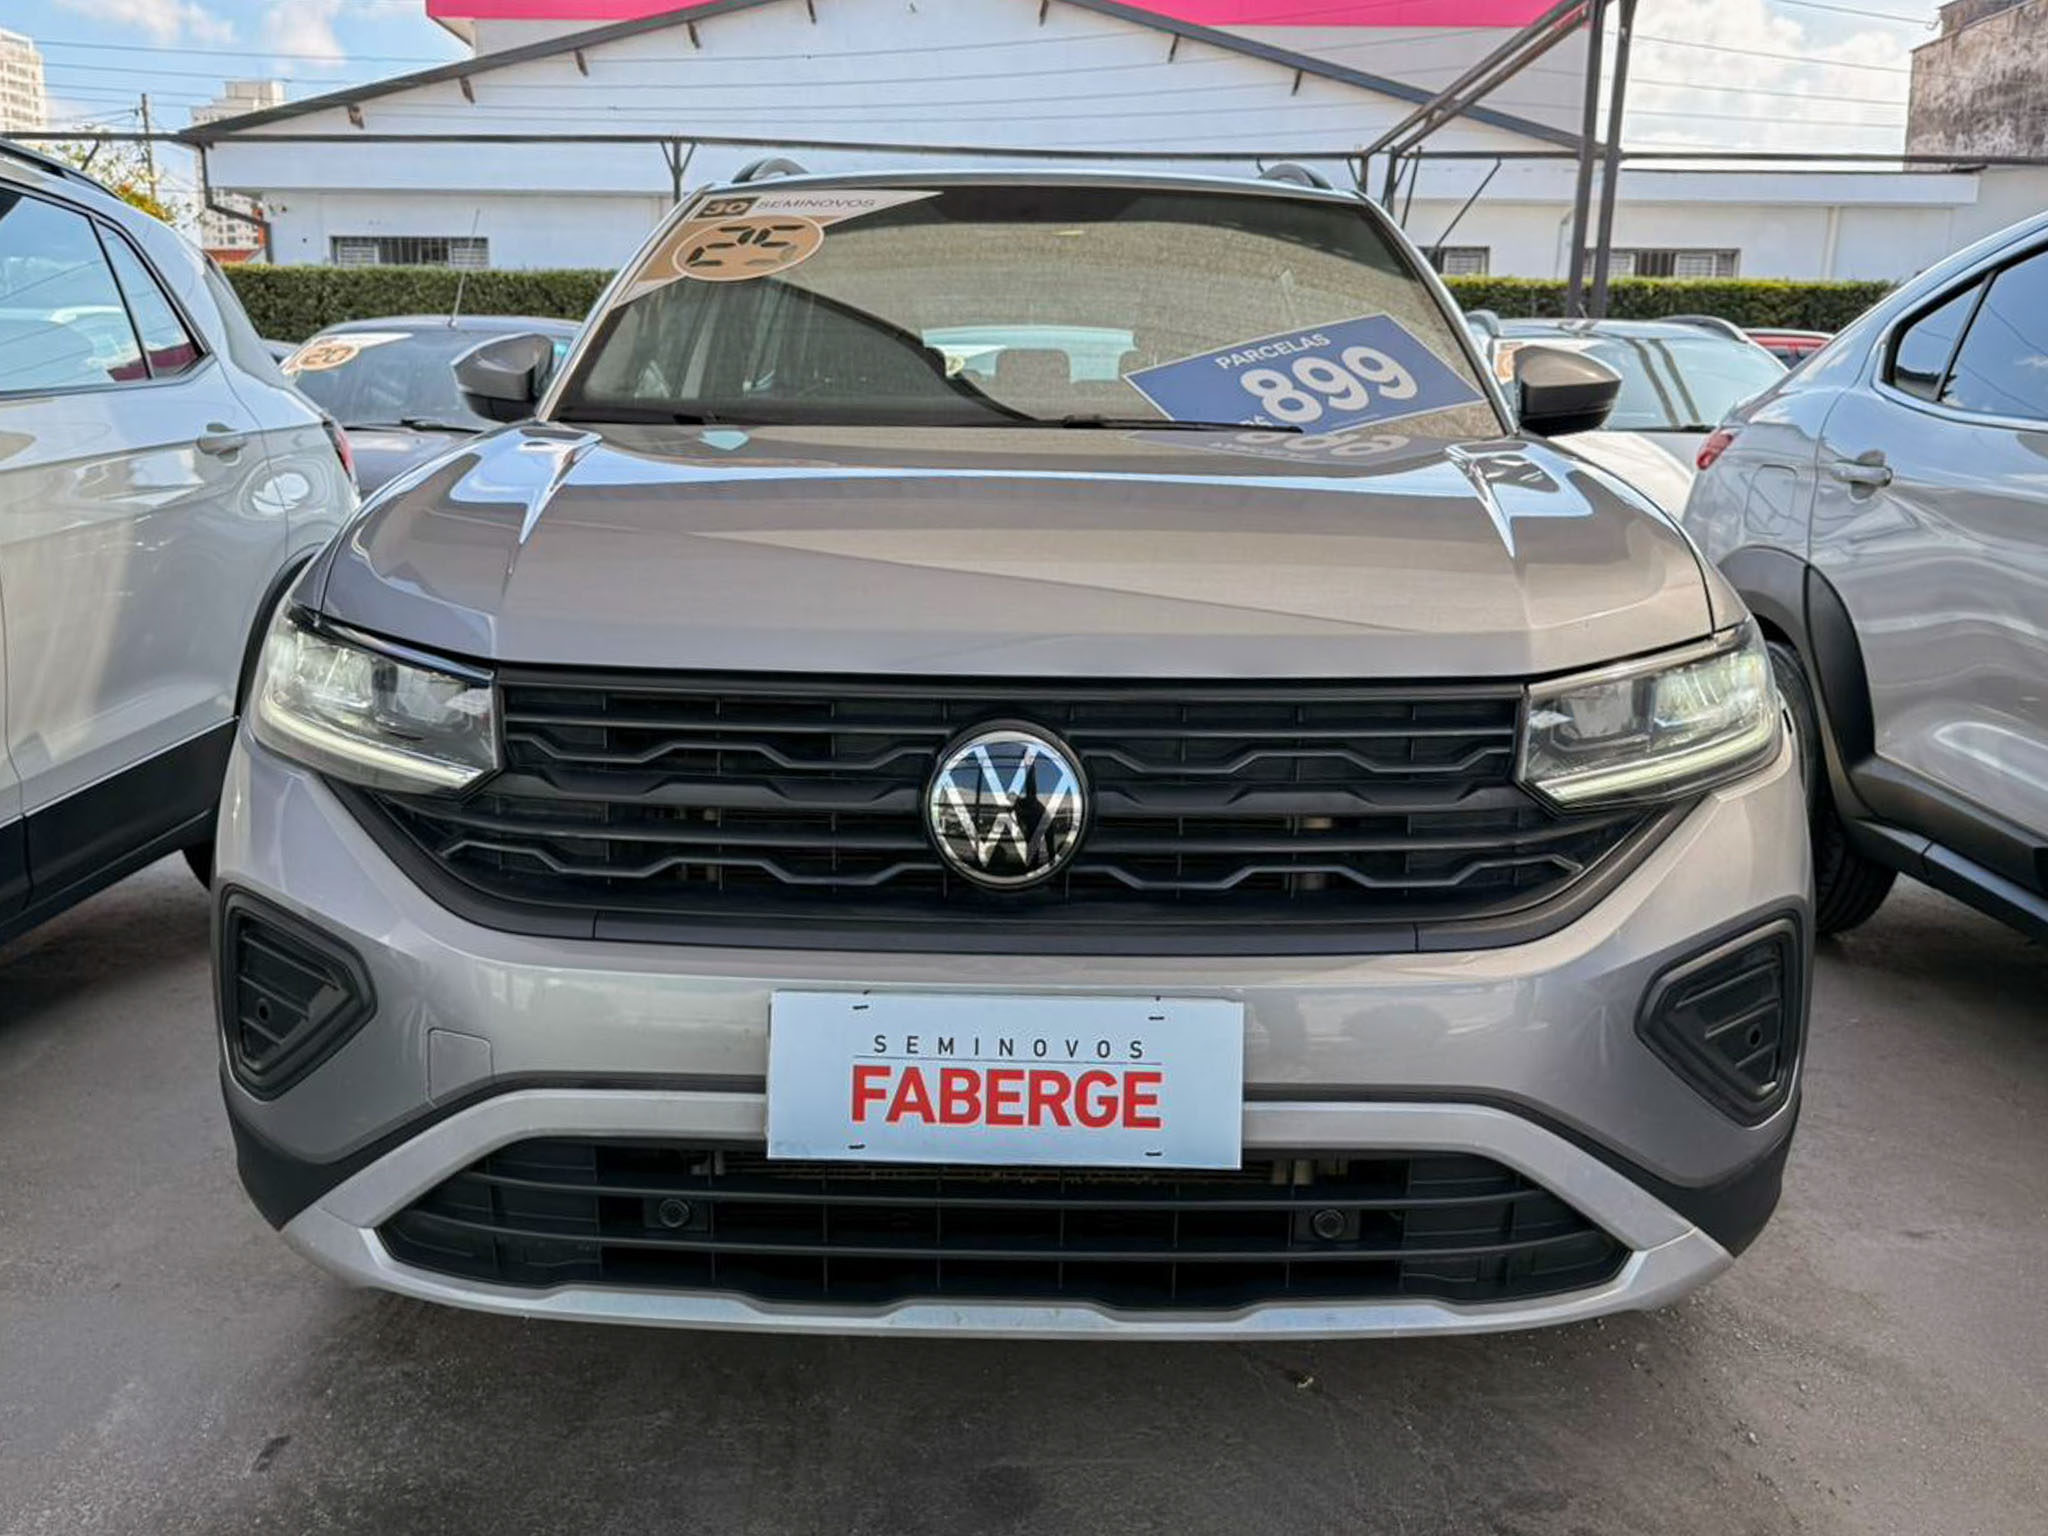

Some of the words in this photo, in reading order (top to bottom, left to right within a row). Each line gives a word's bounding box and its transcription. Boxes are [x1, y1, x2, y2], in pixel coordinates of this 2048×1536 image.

[757, 198, 875, 211] SEMINOVOS
[1215, 333, 1331, 370] PARCELAS
[1239, 346, 1419, 424] 899
[873, 1034, 1144, 1060] SEMINOVOS
[850, 1064, 1163, 1130] FABERGE
